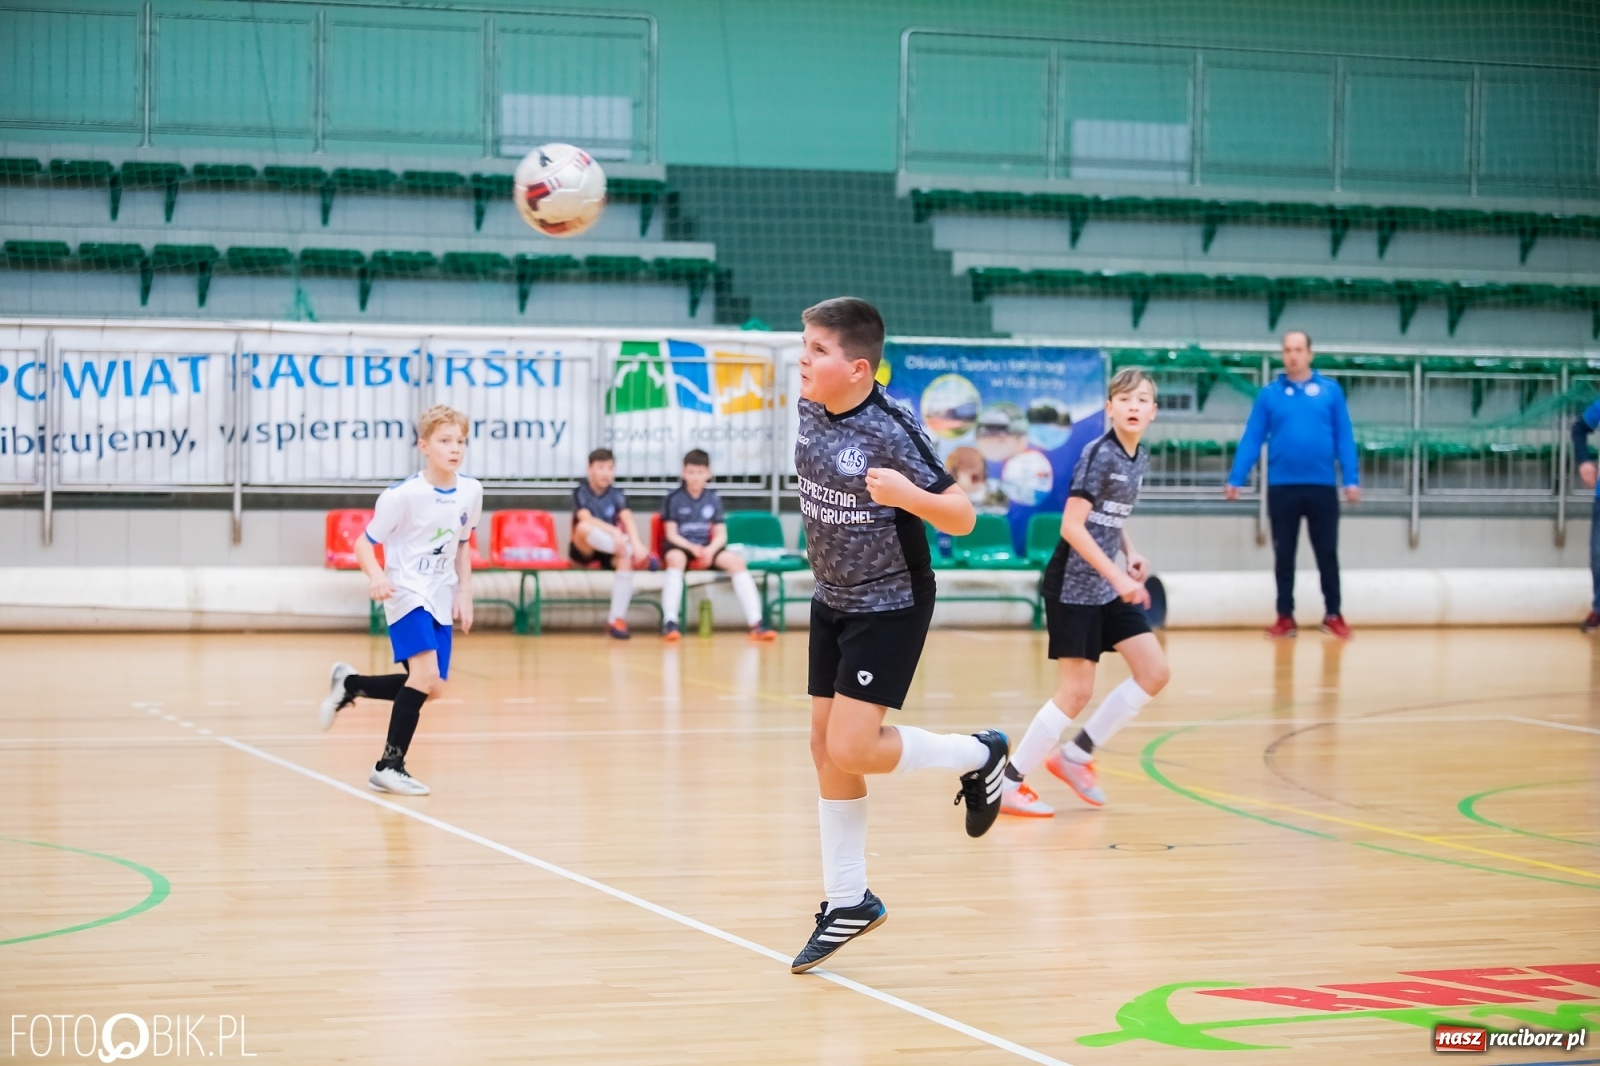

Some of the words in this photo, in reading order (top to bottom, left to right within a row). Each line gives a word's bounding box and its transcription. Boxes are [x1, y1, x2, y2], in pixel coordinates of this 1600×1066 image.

[232, 347, 562, 389] RACIBORSKI
[465, 419, 566, 448] ramy
[841, 450, 863, 468] LKS
[820, 507, 875, 525] GRUCHEL
